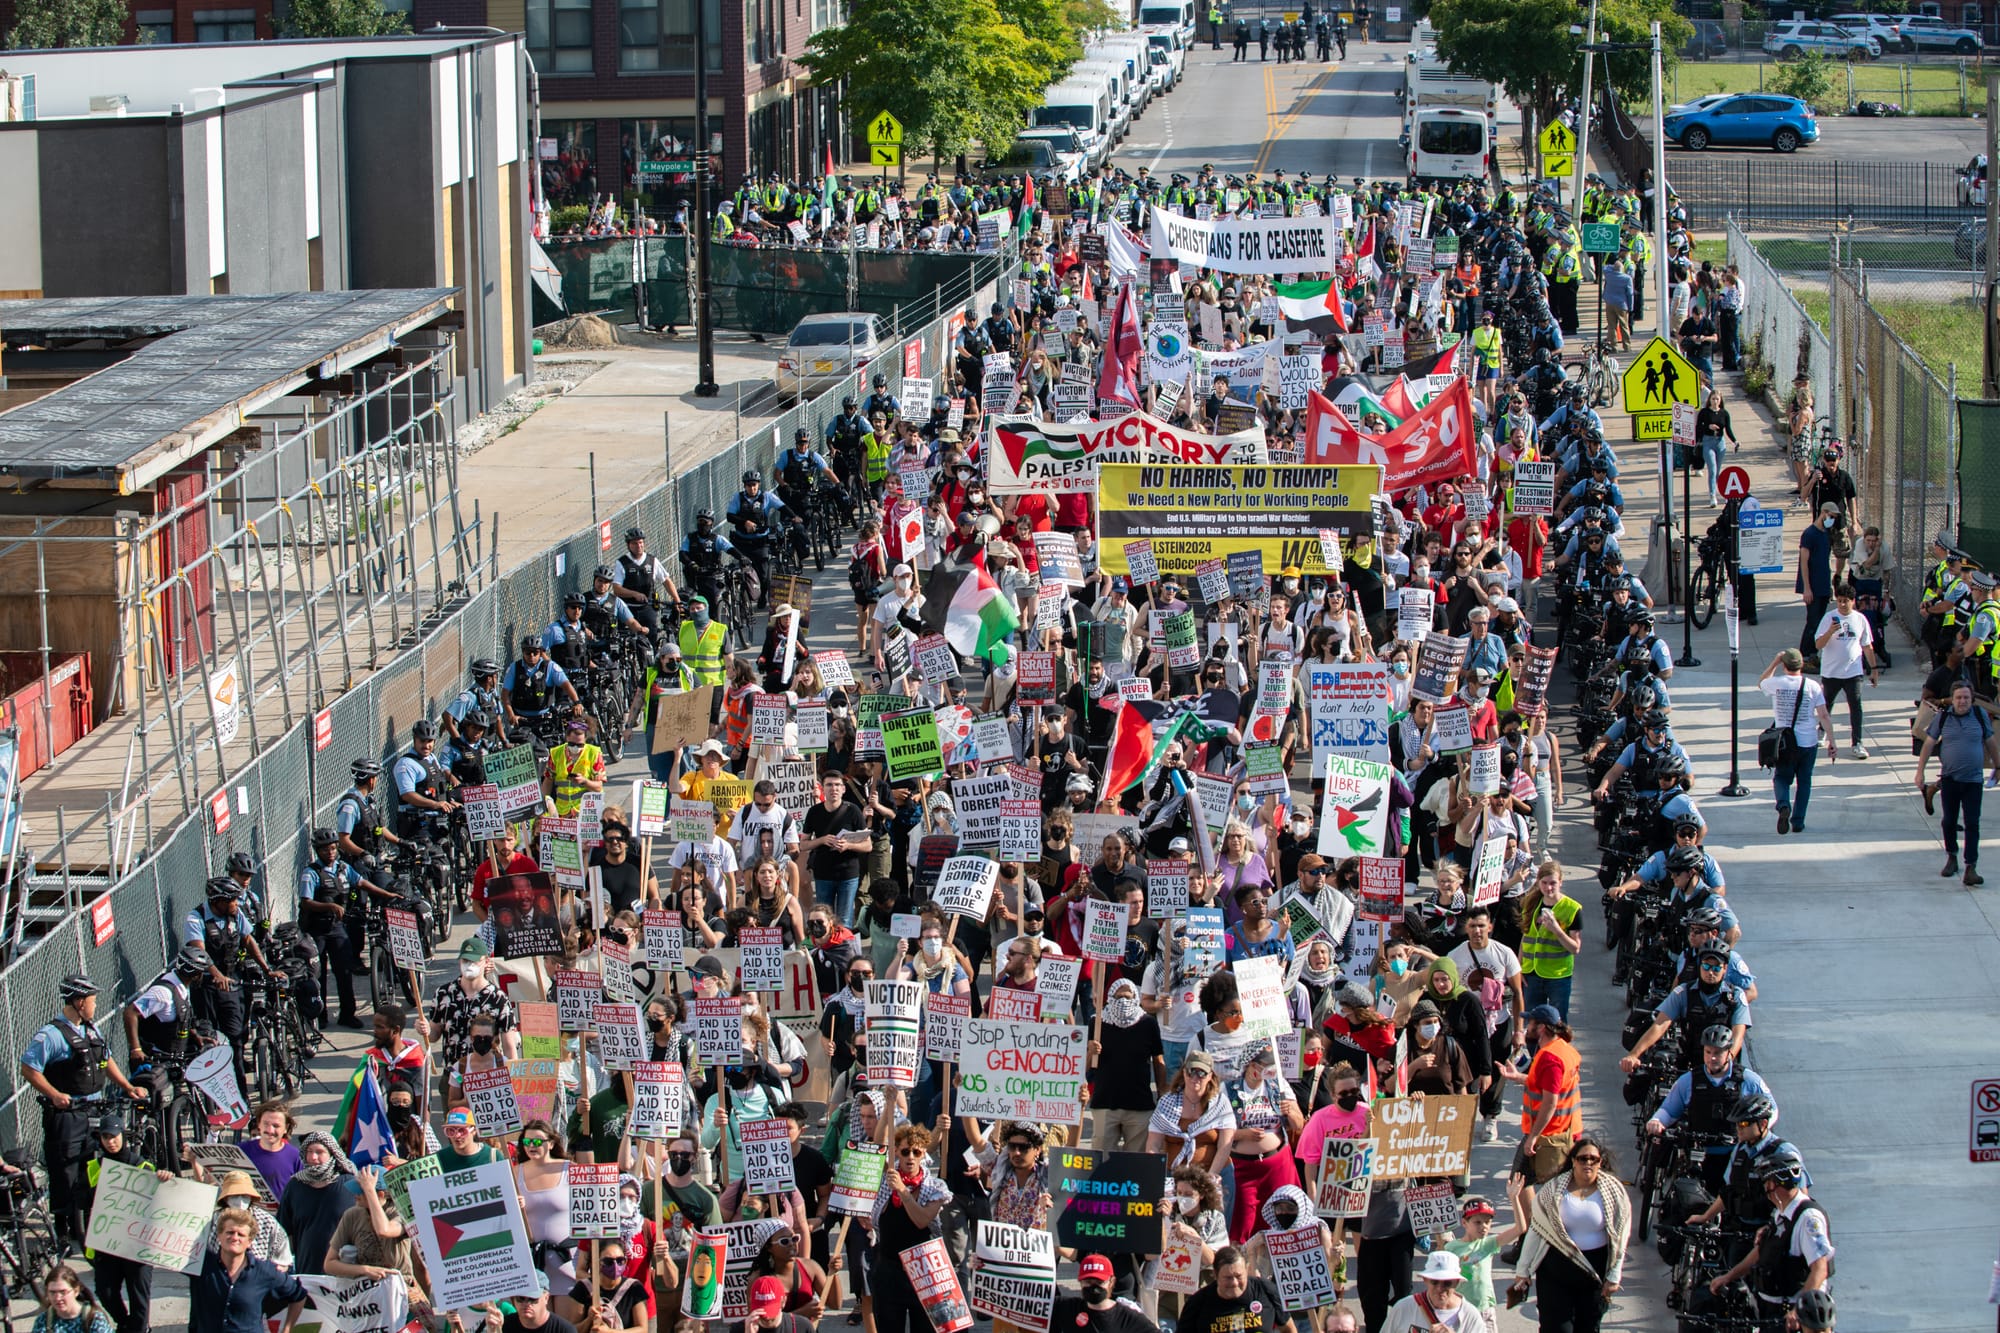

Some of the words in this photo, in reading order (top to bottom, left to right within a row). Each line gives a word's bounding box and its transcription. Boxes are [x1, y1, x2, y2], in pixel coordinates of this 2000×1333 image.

[651, 163, 680, 171] Maypole
[1168, 222, 1232, 261] CHRISTIANS
[1239, 231, 1260, 260] FOR
[1267, 228, 1326, 259] CEASEFIRE
[1156, 293, 1182, 303] VICTORY
[1150, 325, 1163, 337] THE
[1164, 323, 1187, 337] WHOLE
[1149, 354, 1189, 368] WATCHING
[1280, 355, 1309, 368] WHO
[1280, 368, 1319, 381] WOULD
[1057, 385, 1088, 396] VICTORY
[1281, 381, 1320, 393] JESUS
[1076, 416, 1233, 464] VICTORY
[1240, 443, 1255, 455] TO
[1518, 462, 1553, 474] VICTORY
[1141, 468, 1164, 488] NO
[1170, 468, 1236, 490] HARRIS,
[1242, 468, 1266, 488] NO
[1272, 468, 1338, 488] TRUMP!
[1724, 472, 1744, 495] A
[1515, 488, 1552, 497] PALESTINIAN
[1128, 493, 1144, 506] We
[1148, 493, 1174, 506] Need
[1178, 496, 1184, 506] a
[1188, 494, 1210, 506] New
[1214, 494, 1242, 508] Party
[1245, 494, 1261, 506] for
[1264, 494, 1309, 508] Working
[1312, 494, 1348, 508] People
[1515, 497, 1552, 506] RESISTANCE
[1167, 514, 1178, 522] End
[1180, 514, 1191, 522] U.S.
[1192, 514, 1215, 523] Military
[1218, 514, 1227, 522] Aid
[1235, 514, 1246, 522] the
[1248, 514, 1268, 522] Israeli
[1269, 514, 1280, 522] War
[1282, 514, 1310, 522] Machine!
[1424, 650, 1462, 663] LEGACY:
[1312, 671, 1387, 699] FRIENDS
[1320, 702, 1342, 714] don't
[1350, 701, 1374, 714] help
[1436, 712, 1466, 720] IMMIGRANT
[883, 716, 911, 732] LONG
[913, 716, 932, 726] LIVE
[902, 730, 920, 740] THE
[1313, 718, 1388, 747] FRIENDS
[1439, 730, 1453, 738] FOR
[1455, 728, 1469, 736] ALL!
[890, 740, 937, 758] INTIFADA
[1480, 751, 1495, 759] STOP
[485, 751, 532, 774] CHICAGO
[1331, 756, 1389, 783] PALESTINA
[1474, 766, 1497, 774] CRIMES!
[1476, 759, 1497, 767] POLICE
[711, 786, 746, 796] ABANDON
[955, 786, 969, 797] LA
[972, 780, 1010, 796] LUCHA
[1329, 775, 1361, 796] LIBRE
[677, 821, 706, 830] PUBLIC
[677, 831, 707, 840] HEALTH
[946, 860, 992, 876] ISRAELI
[1362, 858, 1376, 866] STOP
[1378, 859, 1401, 867] ARMING
[944, 871, 988, 886] BOMBS
[1362, 865, 1401, 879] ISRAEL
[939, 884, 961, 898] ARE
[963, 888, 984, 902] U.S.
[942, 896, 976, 909] MADE
[1090, 902, 1111, 911] FROM
[1112, 904, 1126, 913] THE
[1098, 911, 1116, 920] SEA
[1092, 926, 1119, 936] RIVER
[1105, 920, 1118, 928] THE
[508, 928, 554, 939] DEMOCRATS
[1090, 934, 1120, 942] PALESTINE
[508, 945, 562, 957] PALESTINIANS
[1086, 944, 1121, 954] FOREVER!
[869, 984, 919, 1006] VICTORY
[882, 1005, 890, 1015] TO
[894, 1006, 905, 1015] THE
[868, 1034, 915, 1049] PALESTINIAN
[967, 1021, 1004, 1049] Stop
[869, 1051, 914, 1067] RESISTANCE
[987, 1049, 1082, 1075] GENOCIDE
[1382, 1100, 1425, 1127] USA
[1438, 1106, 1458, 1122] is
[1389, 1125, 1449, 1154] funding
[190, 1145, 246, 1160] VICTORY
[1327, 1141, 1353, 1157] NO
[570, 1164, 594, 1175] STAND
[596, 1164, 618, 1174] WITH
[1062, 1154, 1093, 1171] USE
[1323, 1148, 1373, 1182] PRIDE
[1373, 1151, 1466, 1176] GENOCIDE
[444, 1170, 478, 1188] FREE
[570, 1172, 618, 1184] PALESTINE!
[1351, 1180, 1366, 1190] IN
[571, 1187, 595, 1199] END
[598, 1187, 616, 1198] U.S
[1060, 1178, 1140, 1197] AMERICA'S
[429, 1185, 504, 1214] PALESTINE
[1319, 1185, 1366, 1211] APARTHEID
[103, 1191, 210, 1232] SLAUGHTER
[572, 1200, 596, 1212] AID
[600, 1200, 617, 1211] TO
[1066, 1199, 1121, 1215] POWER
[1127, 1201, 1153, 1217] FOR
[571, 1212, 618, 1224] ISRAEL!
[93, 1214, 125, 1235] OF
[127, 1221, 203, 1256] CHILDREN
[1075, 1221, 1127, 1238] PEACE
[1268, 1235, 1294, 1245] STAND
[1296, 1228, 1318, 1239] WITH
[983, 1224, 1049, 1254] VICTORY
[1270, 1239, 1320, 1254] PALESTINE!
[106, 1238, 121, 1250] IN
[137, 1248, 183, 1268] GAZA
[444, 1257, 468, 1268] WHITE
[469, 1248, 513, 1262] SUPREMACY
[1004, 1251, 1019, 1262] TO
[1020, 1252, 1032, 1263] THE
[447, 1268, 463, 1276] AND
[464, 1256, 514, 1272] COLONIALISM
[1276, 1257, 1298, 1270] END
[1303, 1252, 1322, 1264] U.S
[445, 1276, 459, 1285] ARE
[477, 1270, 488, 1278] MY
[490, 1263, 520, 1276] VALUES.
[1280, 1269, 1302, 1283] AID
[1309, 1264, 1325, 1277] TO
[975, 1276, 1052, 1299] PALESTINIAN
[1283, 1277, 1330, 1295] ISRAEL!
[974, 1287, 1050, 1317] RESISTANCE
